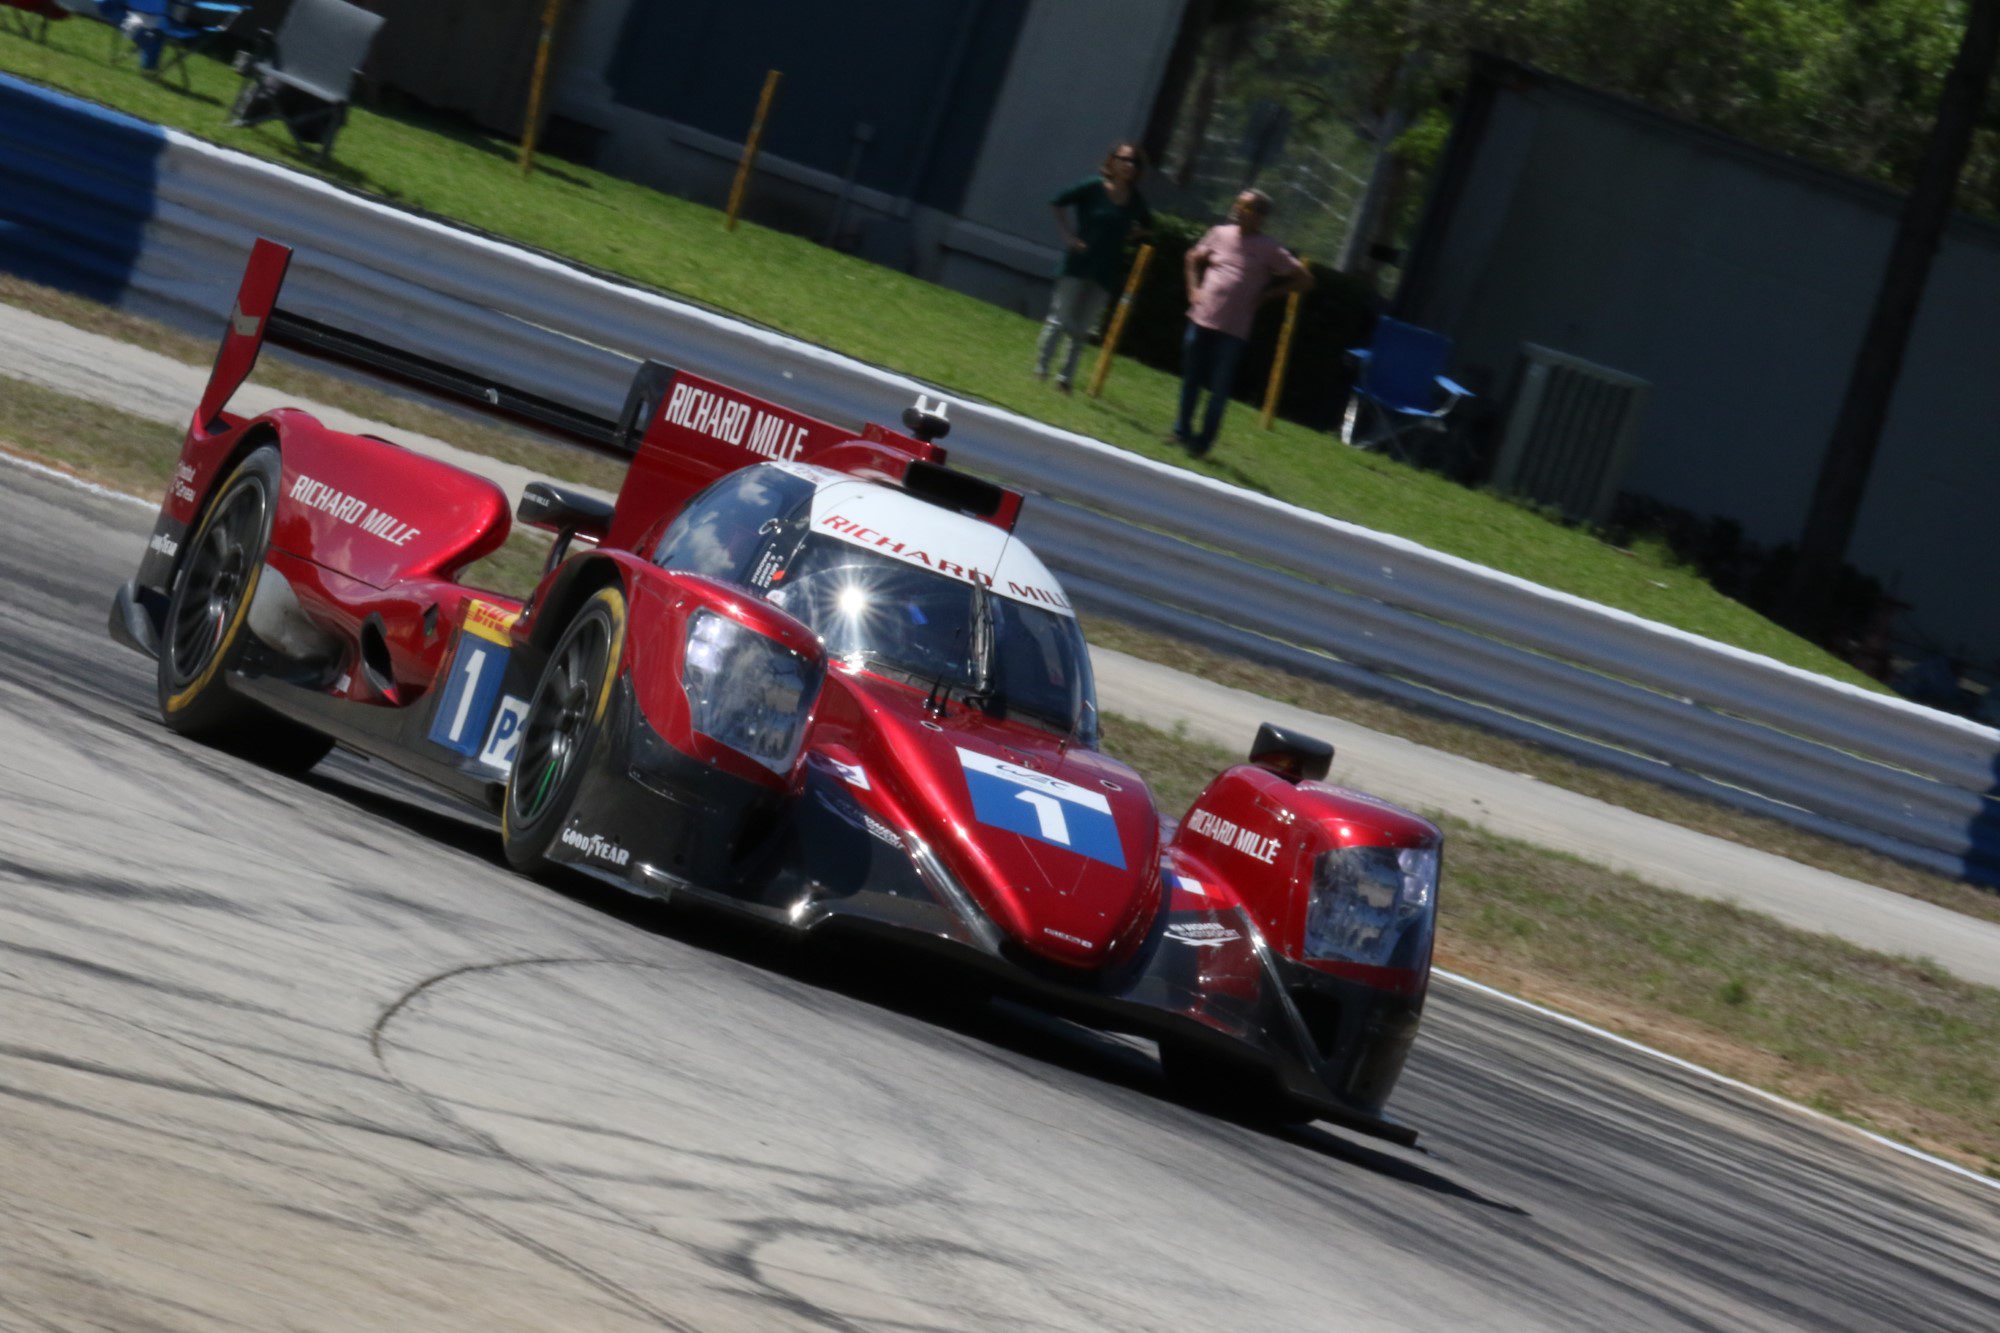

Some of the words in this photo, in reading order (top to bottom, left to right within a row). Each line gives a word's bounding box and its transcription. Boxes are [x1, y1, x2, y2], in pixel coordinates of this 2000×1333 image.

[665, 383, 751, 446] RICHARD
[746, 410, 809, 464] MILLE
[289, 474, 367, 525] RICHARD
[359, 508, 421, 546] MILLE
[822, 515, 993, 587] RICHARD
[1008, 581, 1073, 610] MILL
[449, 649, 486, 743] 1
[562, 827, 630, 866] GOODYEAR
[1014, 790, 1071, 846] 1
[1187, 808, 1237, 846] RICHARD
[1236, 828, 1282, 864] MILLE
